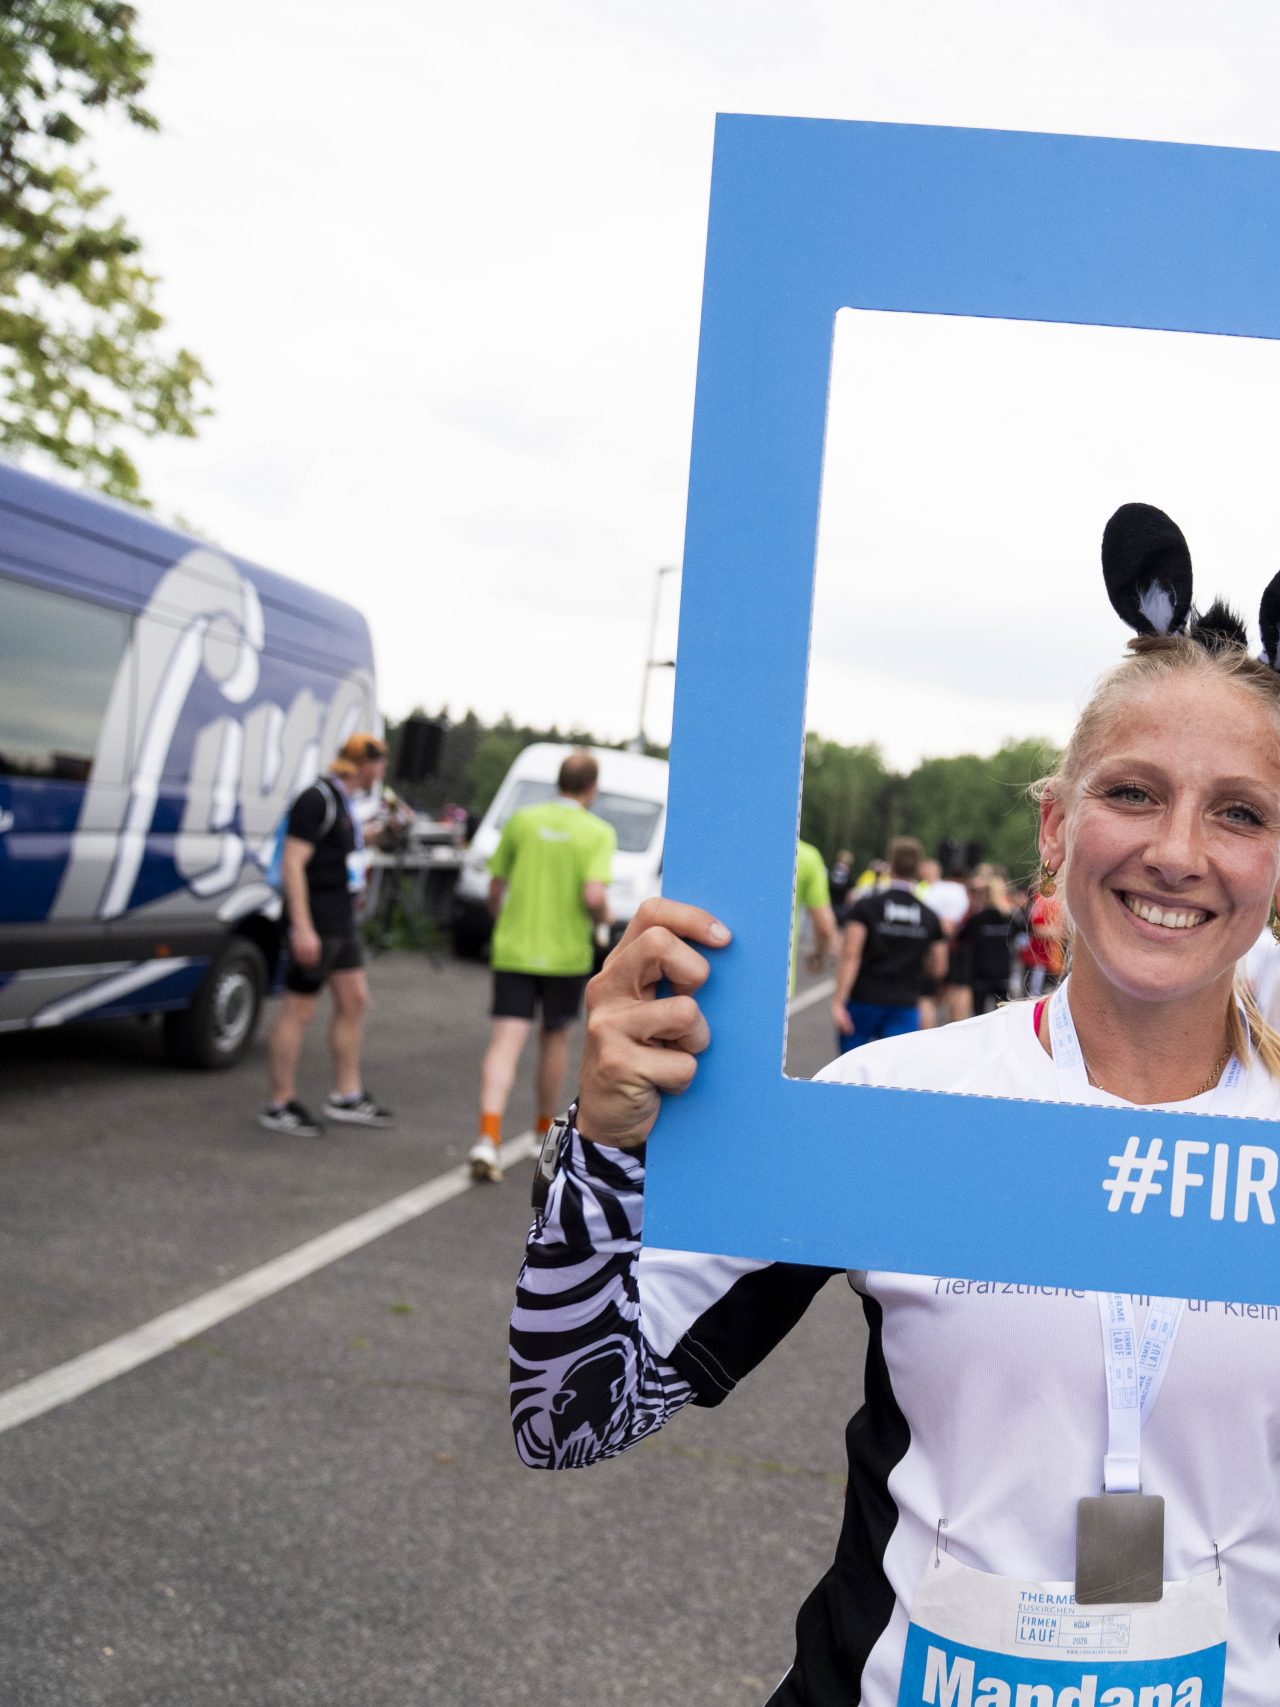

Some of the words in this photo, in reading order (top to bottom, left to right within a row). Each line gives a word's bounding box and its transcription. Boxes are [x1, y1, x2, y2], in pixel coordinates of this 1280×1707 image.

[1112, 1331, 1125, 1357] LAUF
[1148, 1342, 1161, 1369] LAUF
[1020, 1591, 1076, 1605] THERME
[1018, 1603, 1076, 1615] EUSKIRCHEN
[1021, 1615, 1057, 1628] FIRMEN
[1073, 1620, 1090, 1629] KÖLN
[1020, 1627, 1056, 1643] LAUF
[1072, 1636, 1088, 1645] 2026
